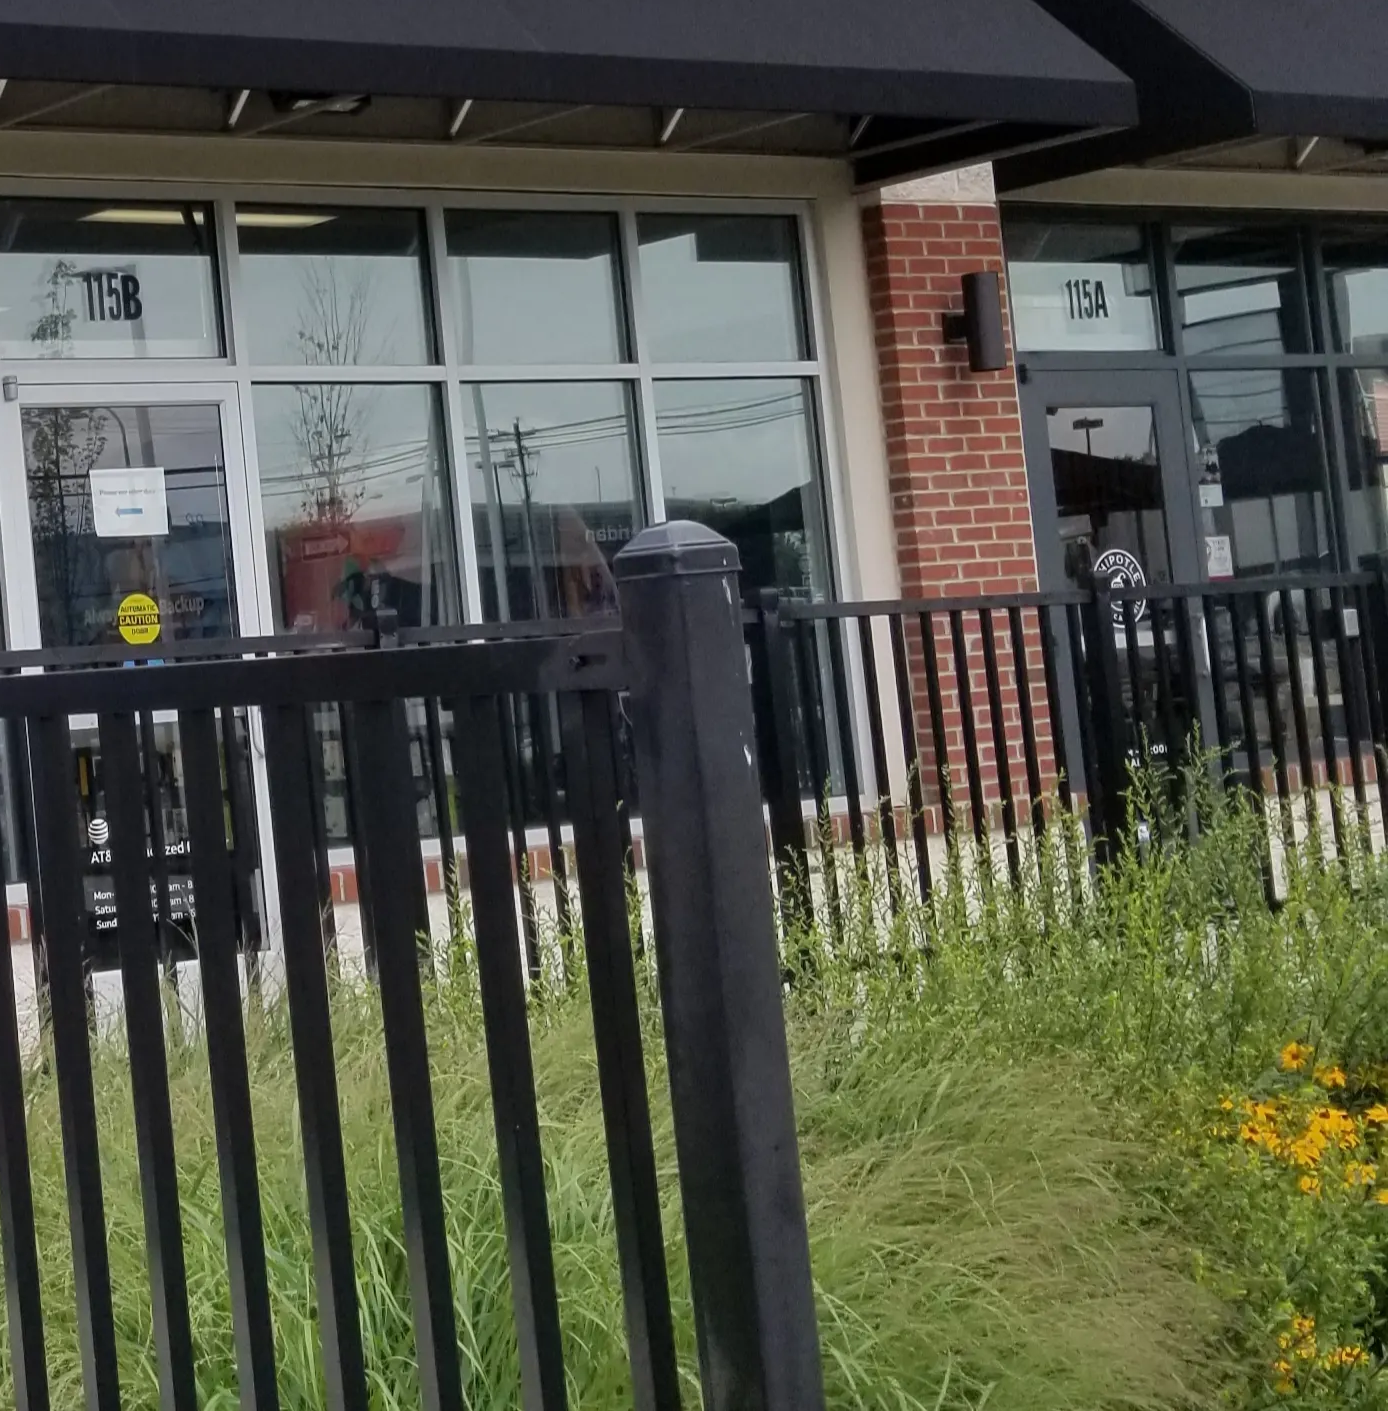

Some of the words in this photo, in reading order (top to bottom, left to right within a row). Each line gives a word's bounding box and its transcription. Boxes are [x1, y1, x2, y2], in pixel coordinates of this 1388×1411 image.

[82, 272, 143, 321] 115B
[1065, 279, 1109, 319] 115A
[1098, 554, 1141, 582] HIPOTLE
[120, 604, 157, 613] AUTOMATIC
[158, 595, 205, 616] Backup
[119, 614, 159, 626] CAUTION
[96, 918, 118, 930] Sund
